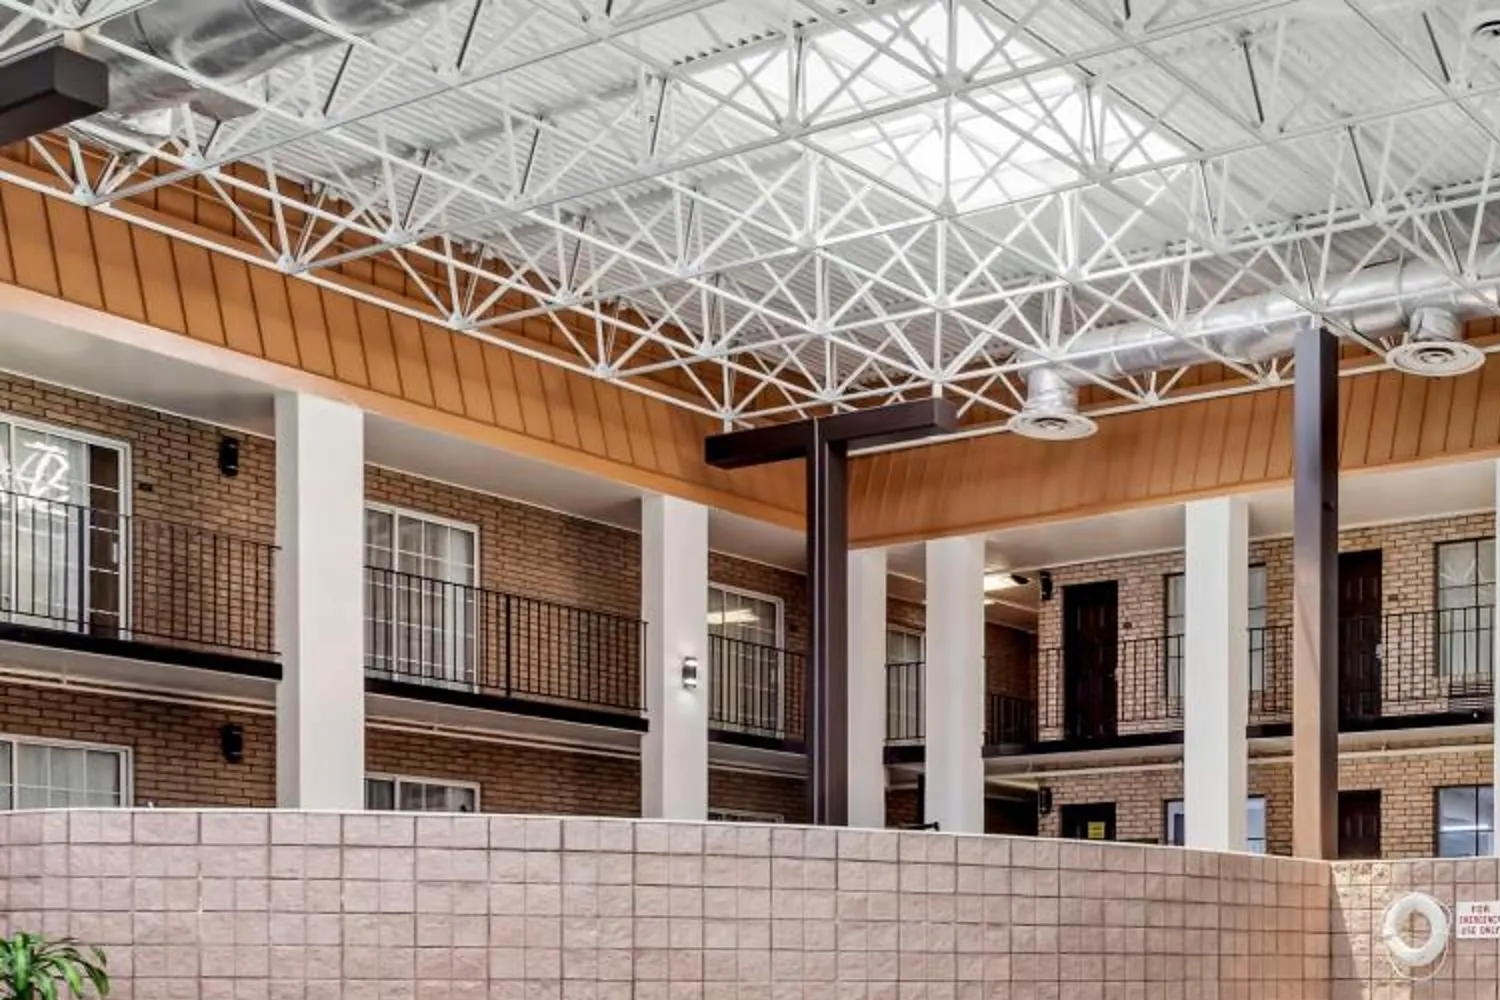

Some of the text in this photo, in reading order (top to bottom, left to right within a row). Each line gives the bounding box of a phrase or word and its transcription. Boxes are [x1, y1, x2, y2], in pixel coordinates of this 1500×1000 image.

[1471, 904, 1490, 914] FOR
[1461, 925, 1500, 935] USE ONLY
